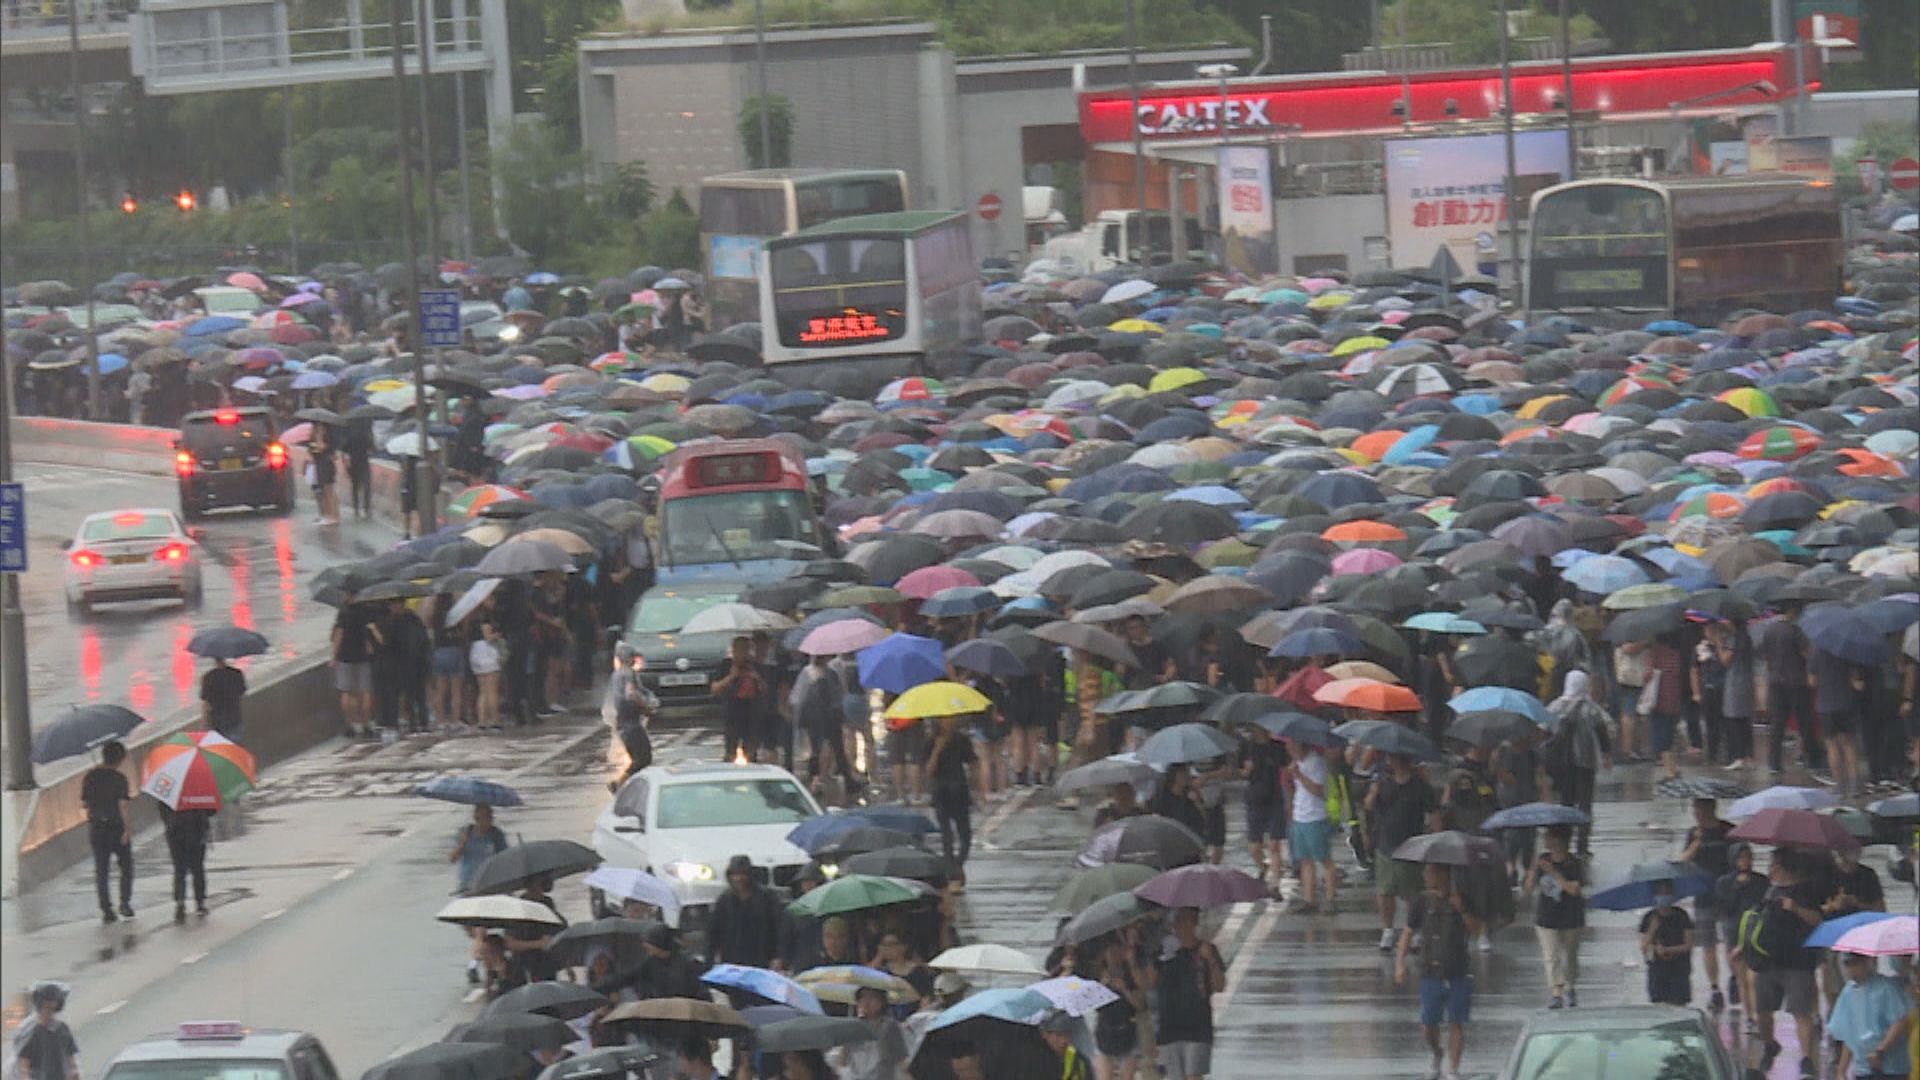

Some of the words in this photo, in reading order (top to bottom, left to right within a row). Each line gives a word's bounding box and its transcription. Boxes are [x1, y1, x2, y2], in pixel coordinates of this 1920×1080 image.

[1138, 98, 1270, 133] CALTEX
[1413, 198, 1509, 227] 創動力
